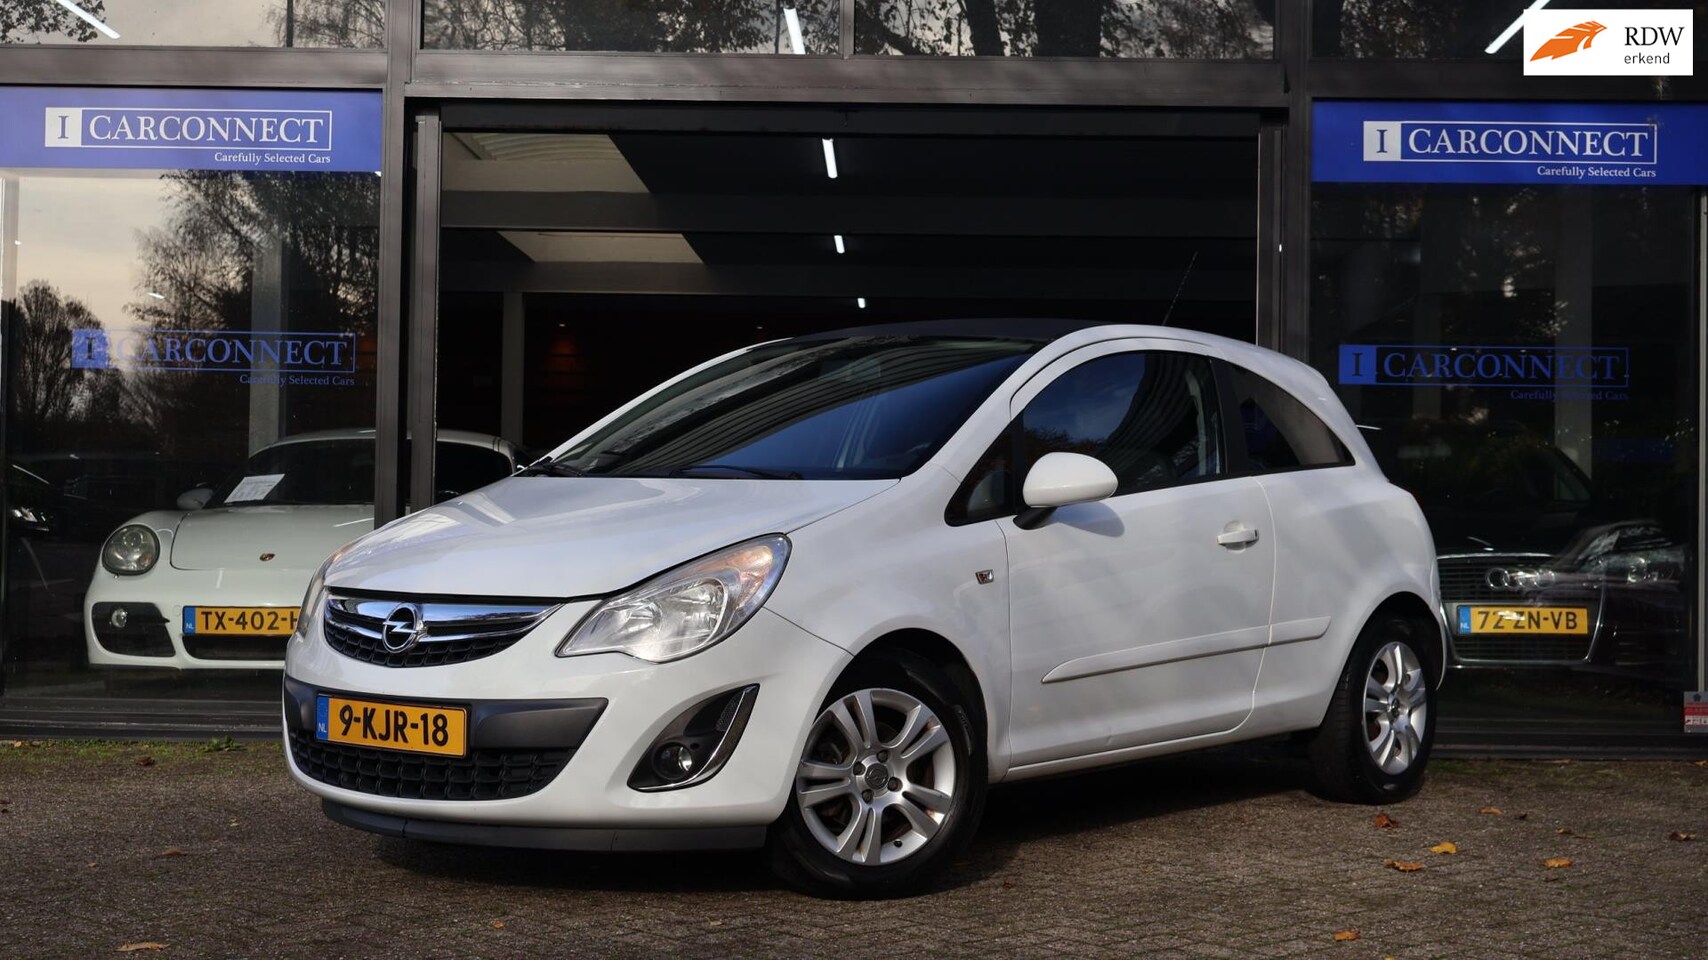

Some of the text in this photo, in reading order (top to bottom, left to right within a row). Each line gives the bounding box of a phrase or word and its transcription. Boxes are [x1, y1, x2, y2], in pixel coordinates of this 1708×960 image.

[58, 114, 324, 144] I CARCONNECT
[1376, 128, 1649, 157] I CARCONNECT
[214, 152, 331, 166] Carefully Selected Cars
[1537, 166, 1656, 179] Carefully Selected Cars
[116, 337, 347, 366] CARCONNECT
[1383, 352, 1620, 380] CARCONNECT
[288, 375, 329, 386] Selected
[332, 376, 355, 386] Cars
[1478, 611, 1578, 630] 72ZN-VB
[318, 722, 328, 733] NL
[339, 704, 449, 747] 9-KJR-18
